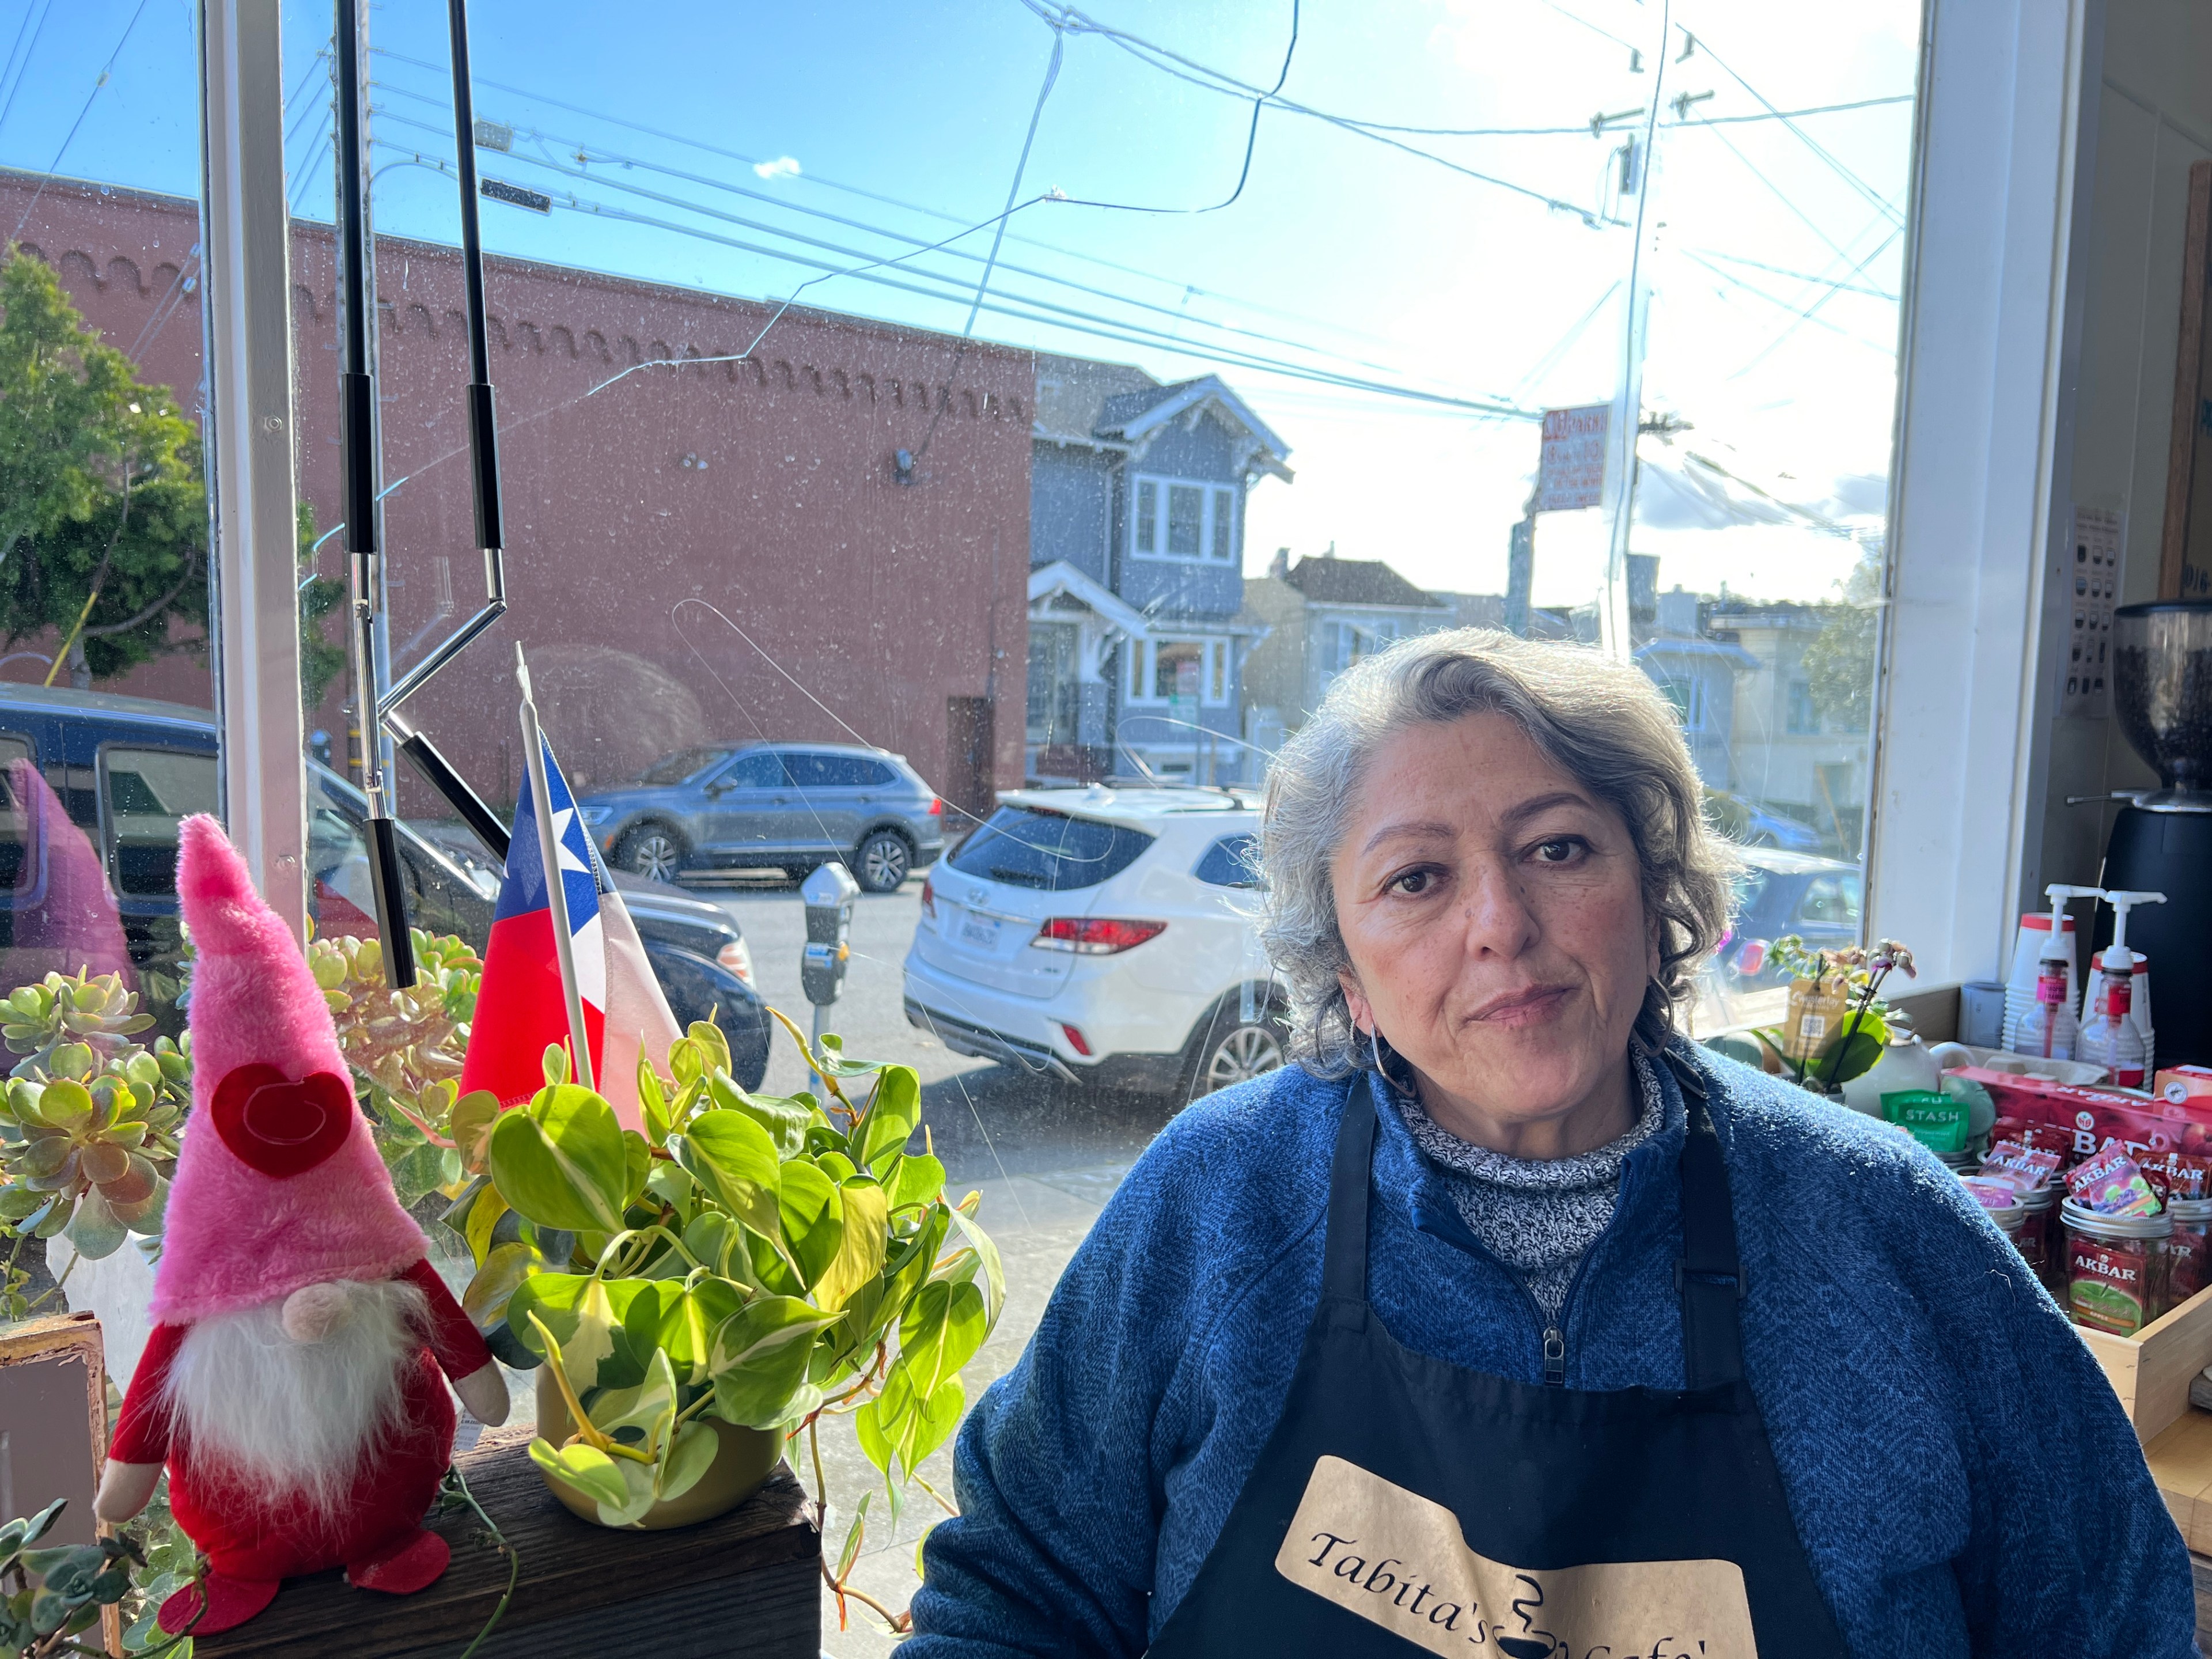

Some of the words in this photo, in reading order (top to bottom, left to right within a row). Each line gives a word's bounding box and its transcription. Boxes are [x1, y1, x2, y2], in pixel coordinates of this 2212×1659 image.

[1906, 1109, 1959, 1122] STASH
[1993, 1154, 2047, 1176] AKBAR
[2074, 1156, 2127, 1193] AKBAR
[2075, 1255, 2136, 1281] AKBAR
[1308, 1533, 1488, 1643] Tabita's
